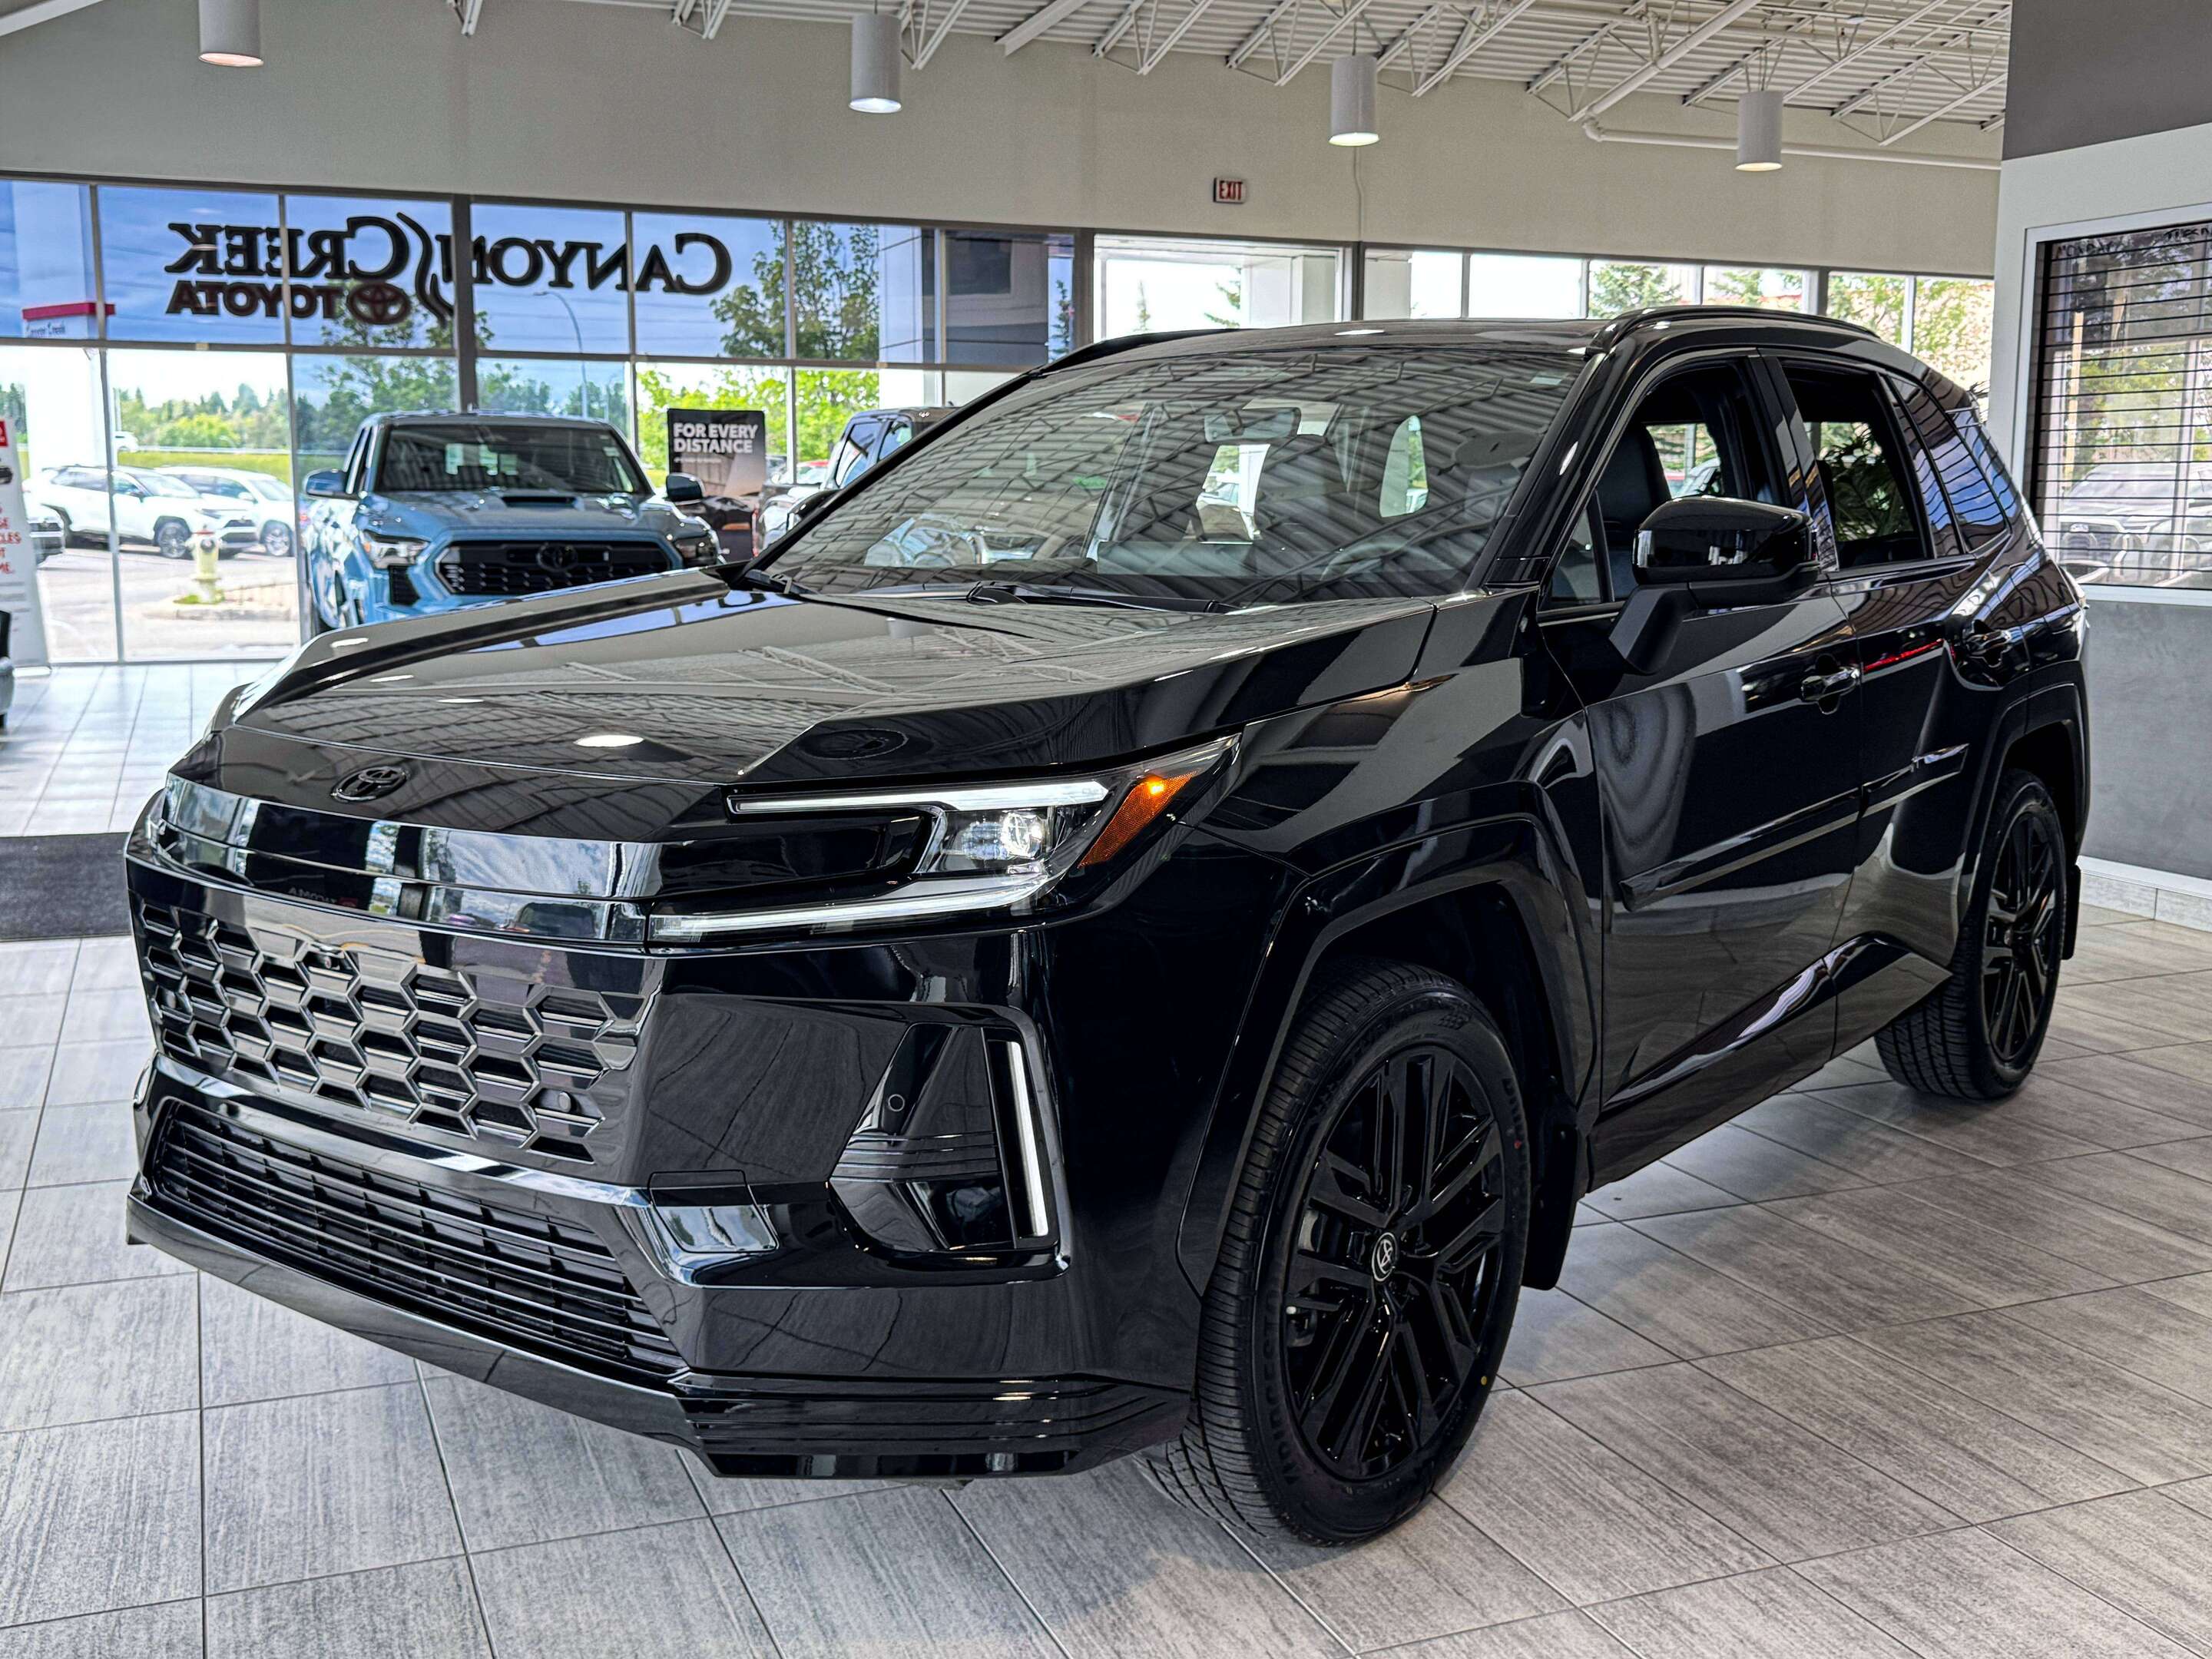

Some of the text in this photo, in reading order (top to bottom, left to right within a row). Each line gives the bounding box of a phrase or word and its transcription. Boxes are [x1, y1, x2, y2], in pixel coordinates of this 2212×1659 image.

[1219, 180, 1243, 200] EXIT
[673, 422, 758, 439] FOR EVERY
[673, 438, 753, 453] DISTANCE
